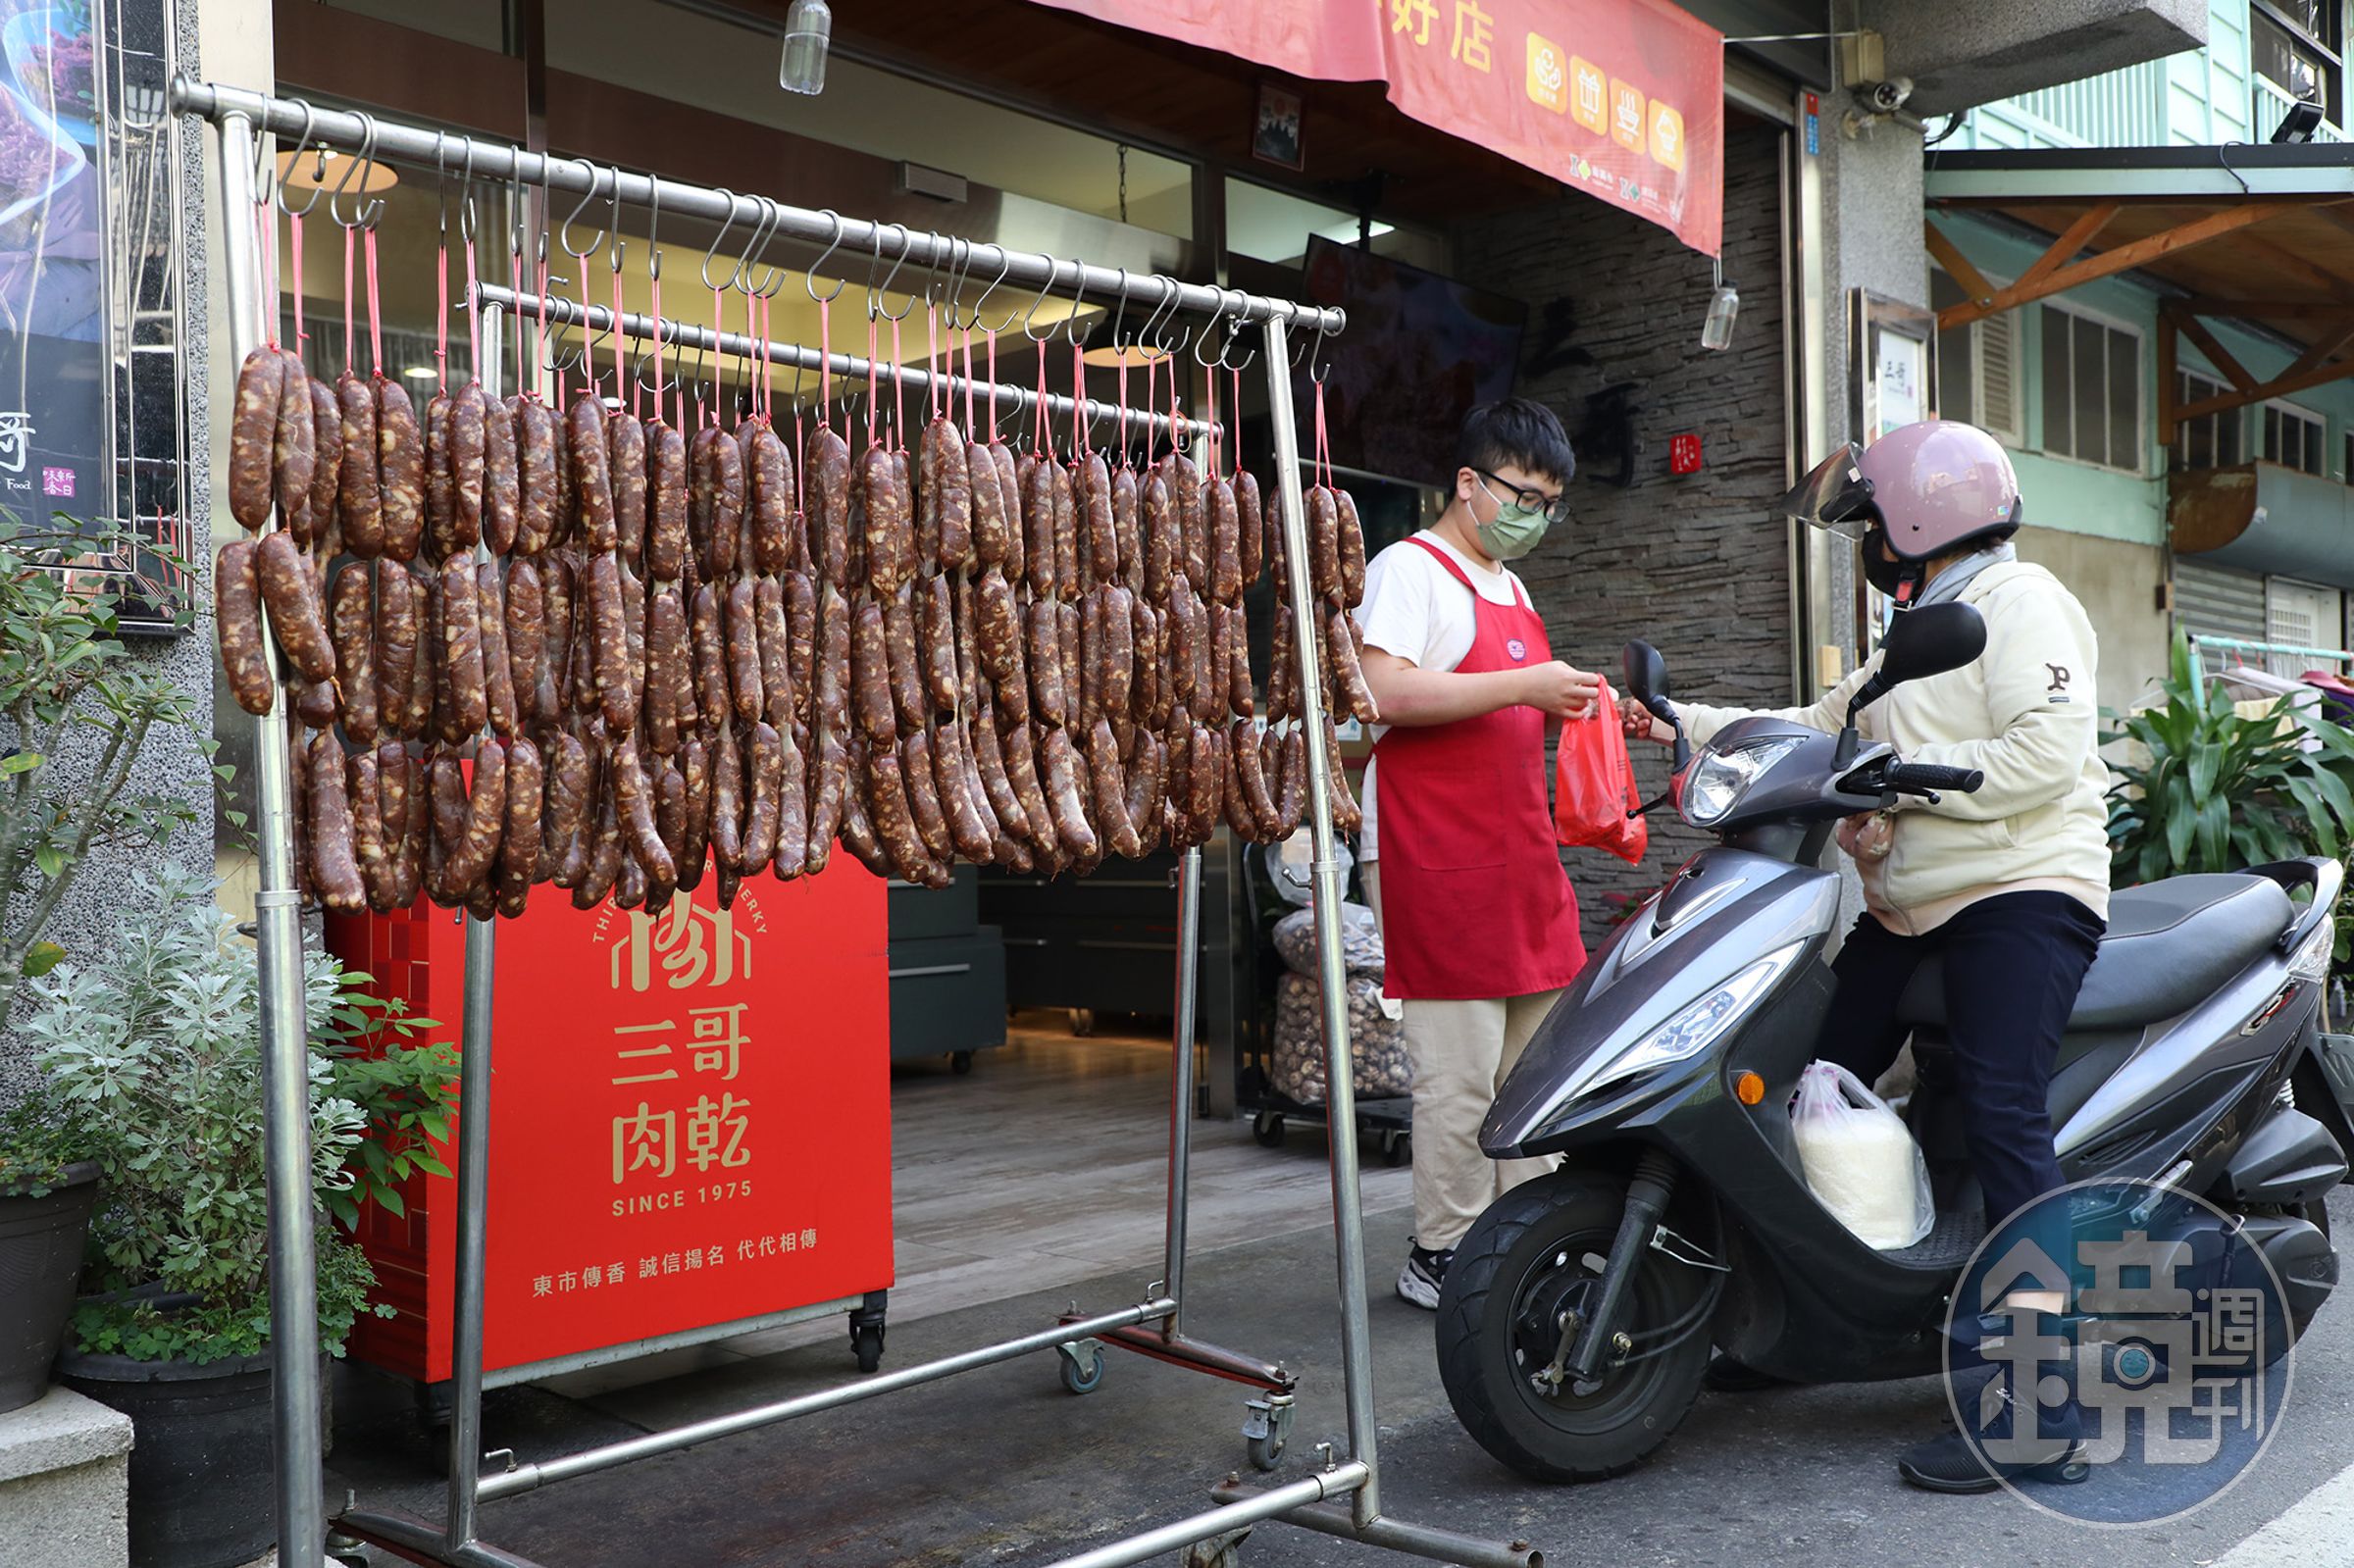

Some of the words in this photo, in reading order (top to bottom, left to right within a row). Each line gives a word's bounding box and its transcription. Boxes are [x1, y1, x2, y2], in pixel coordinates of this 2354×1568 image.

[5, 478, 31, 490] Food
[612, 1003, 751, 1085] 三哥
[612, 1091, 751, 1185] 肉乾
[612, 1190, 685, 1216] SINCE
[697, 1180, 751, 1203] 1975
[533, 1262, 626, 1297] 東市傳香
[639, 1245, 724, 1279] 誠信揚名
[737, 1228, 817, 1260] 代代相傳
